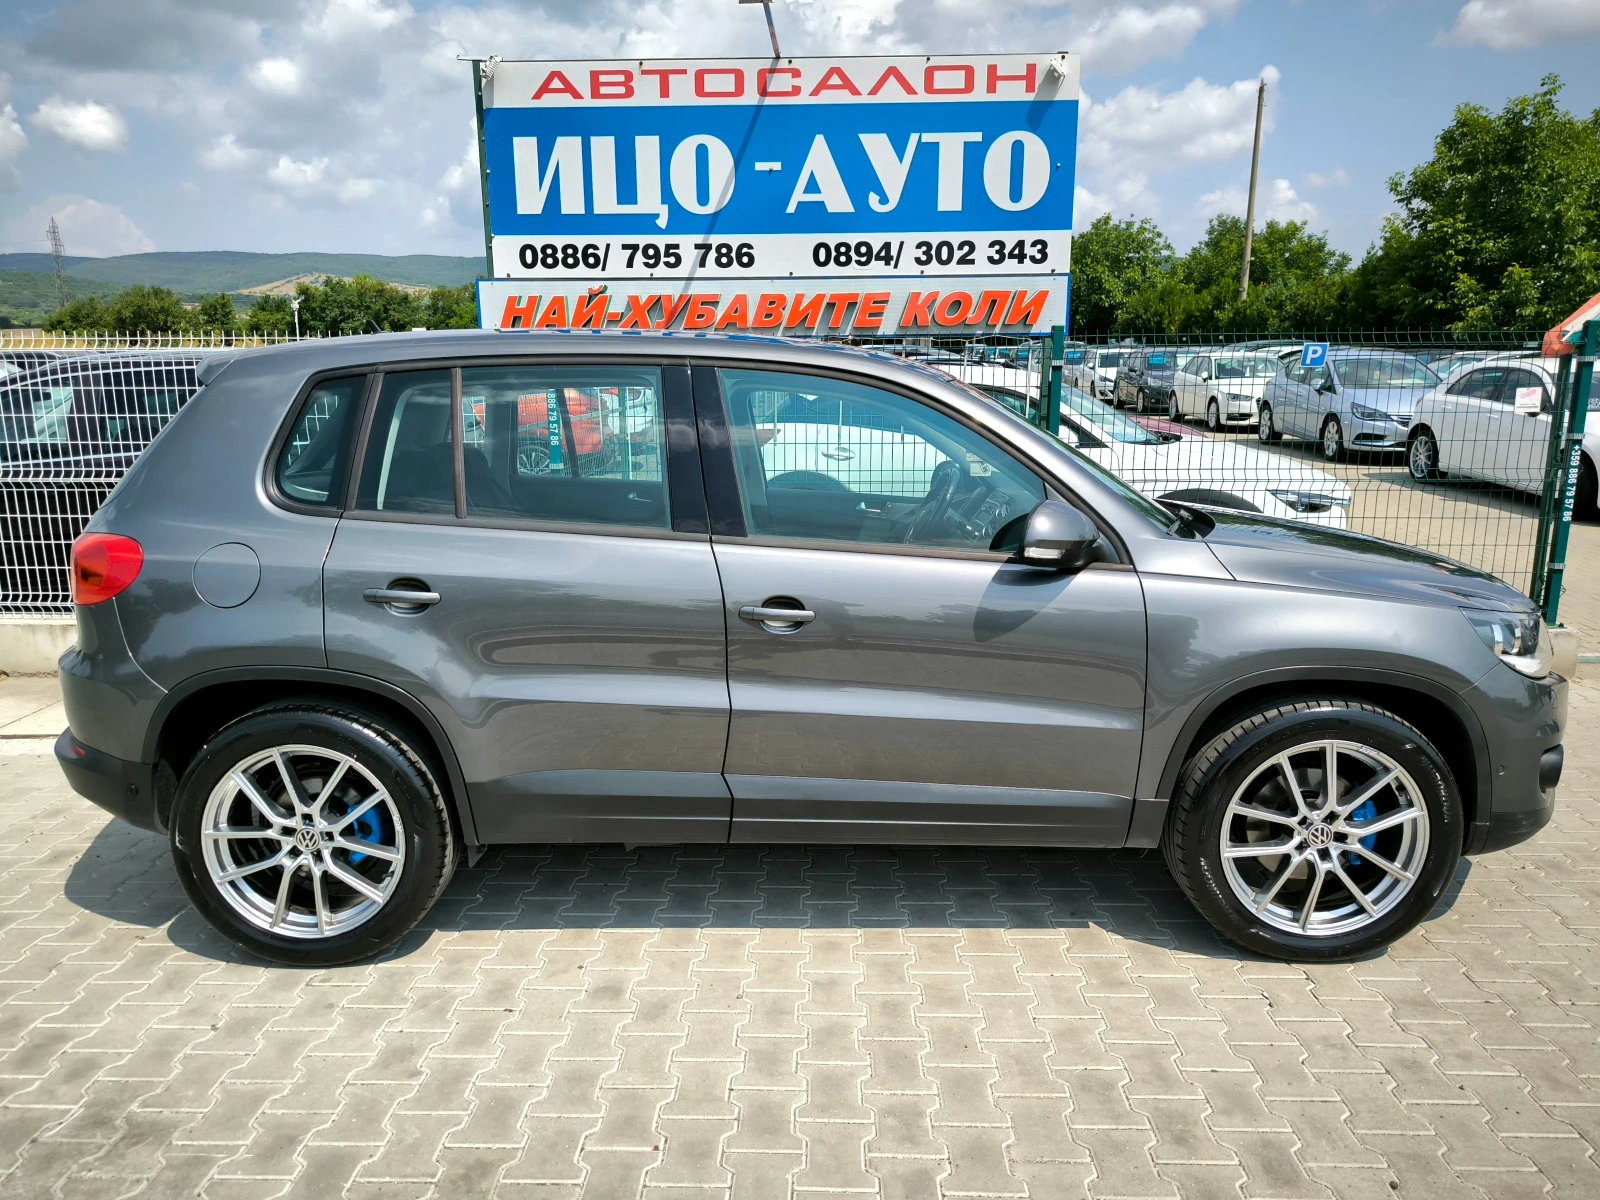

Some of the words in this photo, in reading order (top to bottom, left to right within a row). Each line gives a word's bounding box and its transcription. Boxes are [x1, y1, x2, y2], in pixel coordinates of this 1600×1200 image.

[533, 64, 1037, 101] АВТОСАЛОН
[519, 243, 611, 272] 0886/
[622, 243, 682, 269] 795
[694, 243, 755, 269] 786
[812, 241, 905, 270] 0894/
[915, 240, 976, 266] 302
[986, 239, 1049, 265] 343
[500, 285, 891, 331] НАЙ-ХУБАВИТЕ
[901, 289, 1050, 328] КОЛИ
[1305, 345, 1323, 365] P
[547, 393, 556, 409] 886
[549, 411, 557, 421] 79
[550, 424, 558, 433] 57
[550, 436, 559, 446] 86
[1568, 468, 1578, 484] 886
[1566, 486, 1576, 496] 79
[1564, 499, 1574, 509] 57
[1563, 511, 1573, 521] 86
